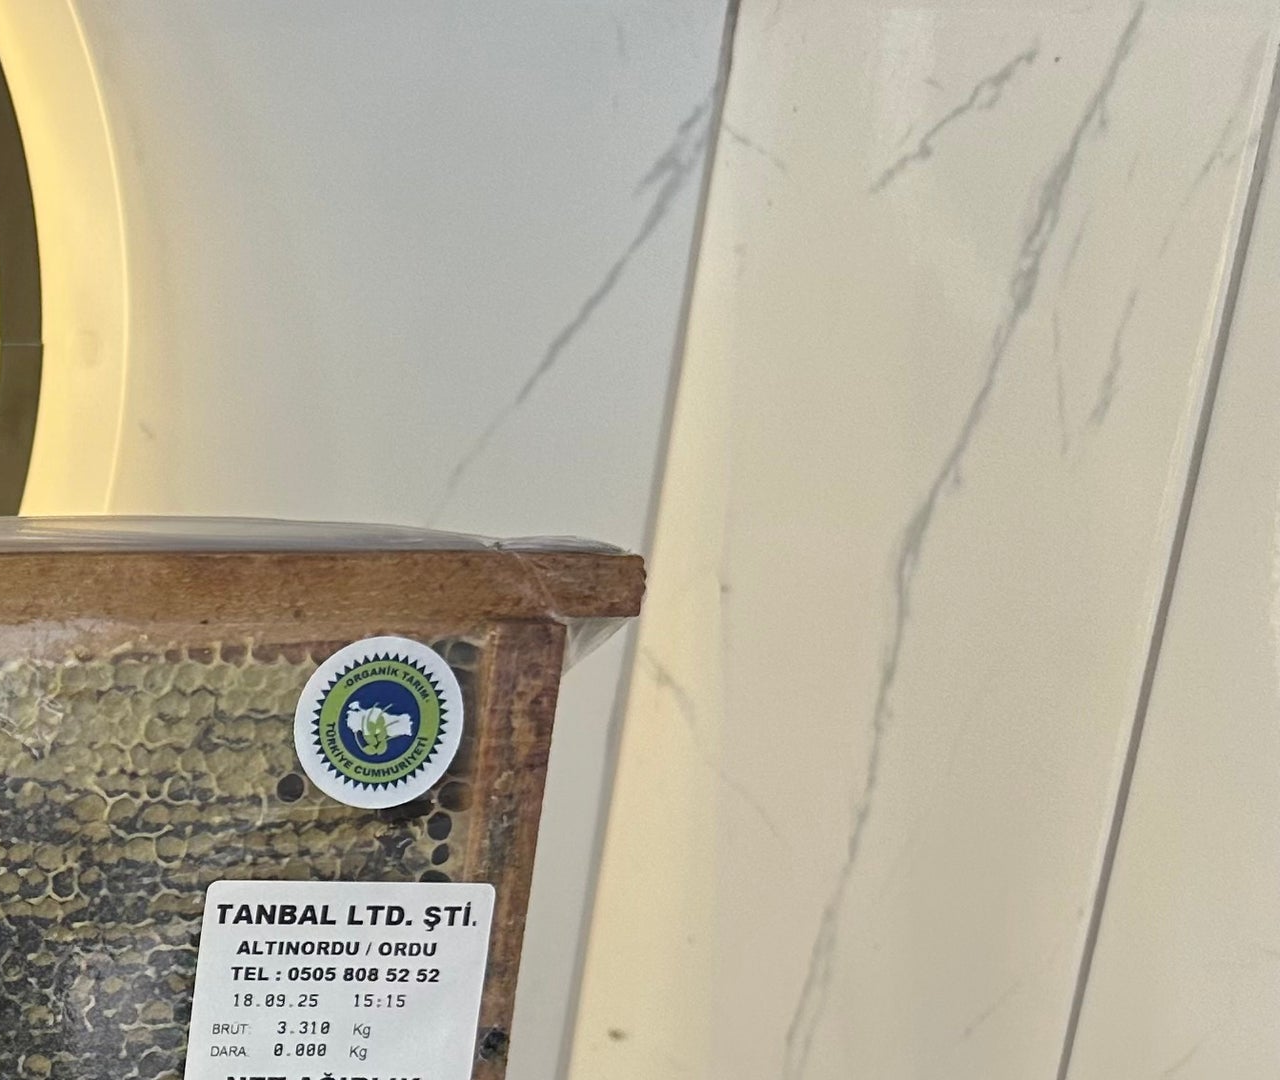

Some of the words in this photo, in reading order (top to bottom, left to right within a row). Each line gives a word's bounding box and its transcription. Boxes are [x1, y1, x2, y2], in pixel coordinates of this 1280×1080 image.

[346, 665, 399, 687] ORGANİK
[401, 670, 429, 700] TARIM
[326, 722, 354, 769] TÜRKİYE
[354, 736, 428, 777] CUMHURİYETİ
[216, 904, 337, 926] TANBAL
[347, 904, 413, 926] LTD.
[422, 901, 477, 932] ŞTİ.
[236, 940, 360, 956] ALTINORDU
[378, 942, 437, 957] ORDU
[231, 966, 269, 982] TEL
[287, 967, 336, 982] 0505
[343, 967, 379, 982] 808
[385, 968, 410, 983] 52
[415, 968, 440, 983] 52
[233, 993, 319, 1008] 18.09.25
[354, 994, 407, 1008] 15:15
[277, 1021, 331, 1036] 3.310
[352, 1023, 371, 1039] Kg
[273, 1043, 327, 1057] 0.000
[349, 1046, 368, 1061] Kg
